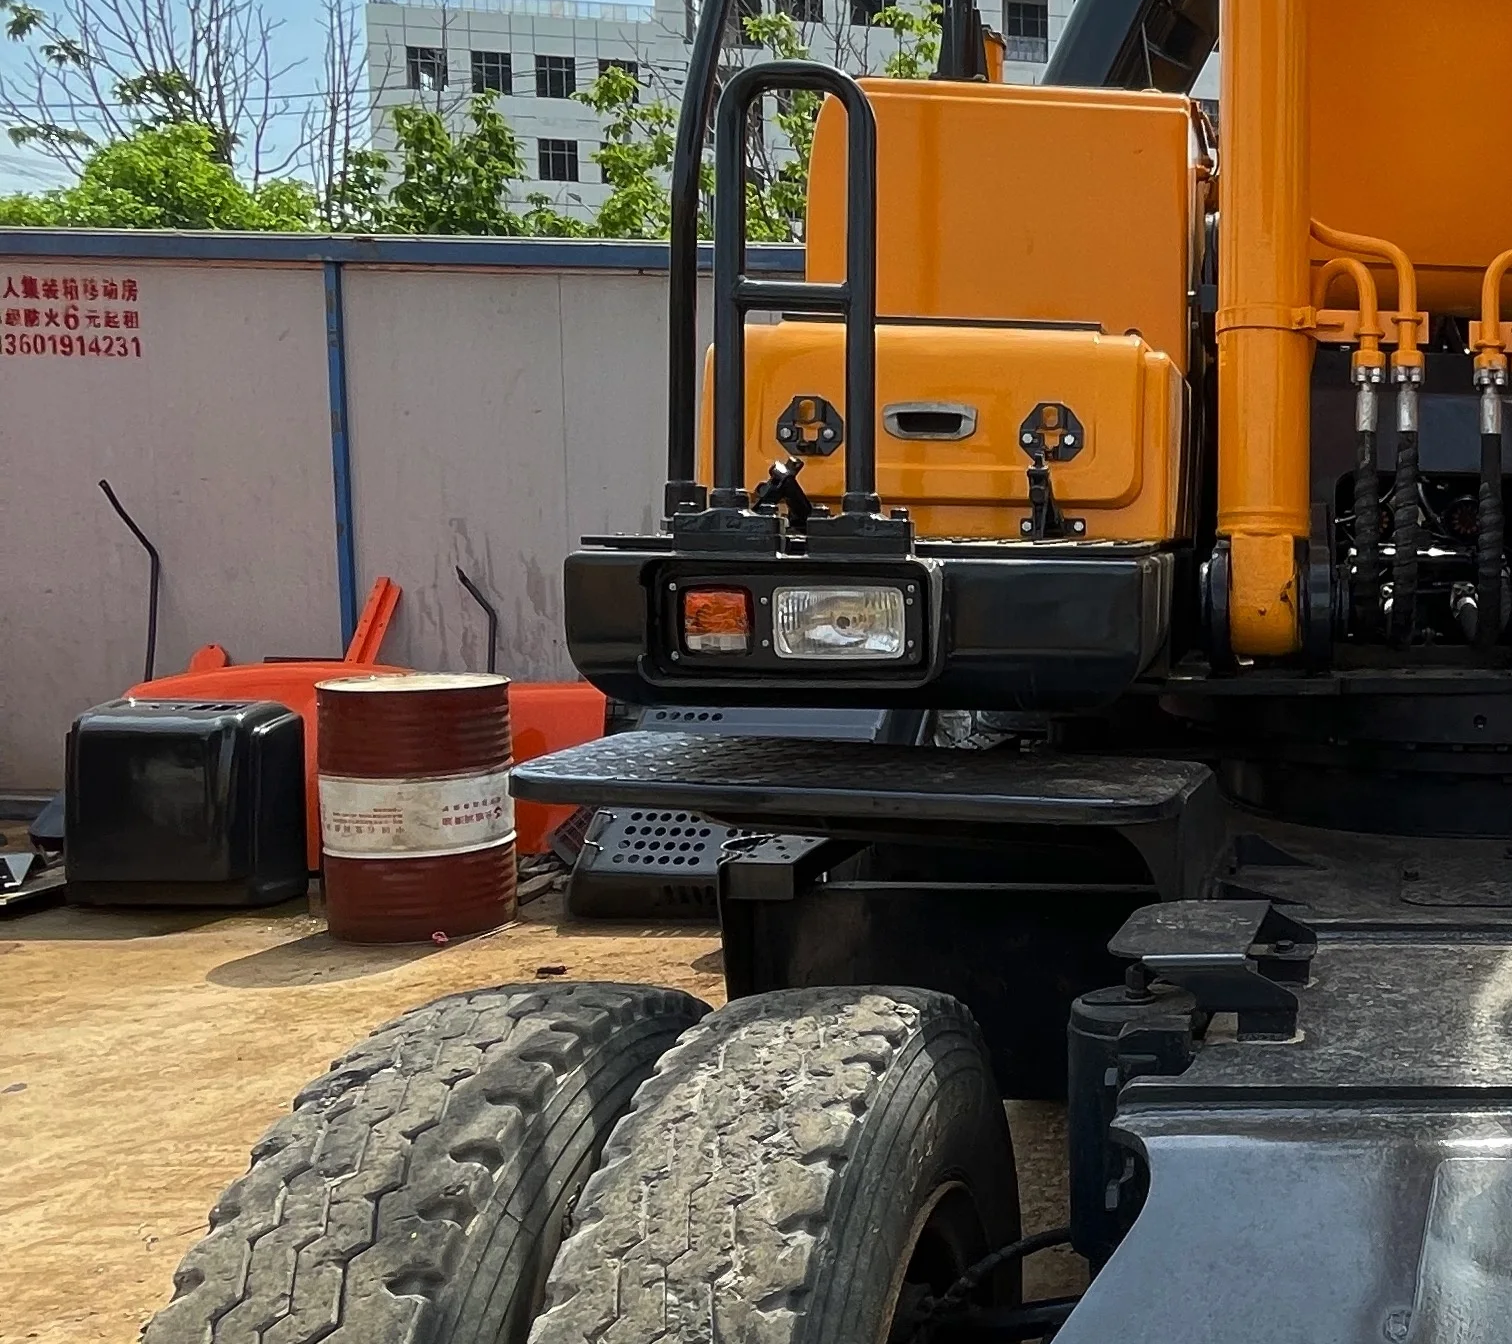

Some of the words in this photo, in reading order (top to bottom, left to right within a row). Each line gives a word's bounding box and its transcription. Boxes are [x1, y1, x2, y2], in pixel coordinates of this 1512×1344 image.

[0, 304, 139, 330] 级防火6元起租
